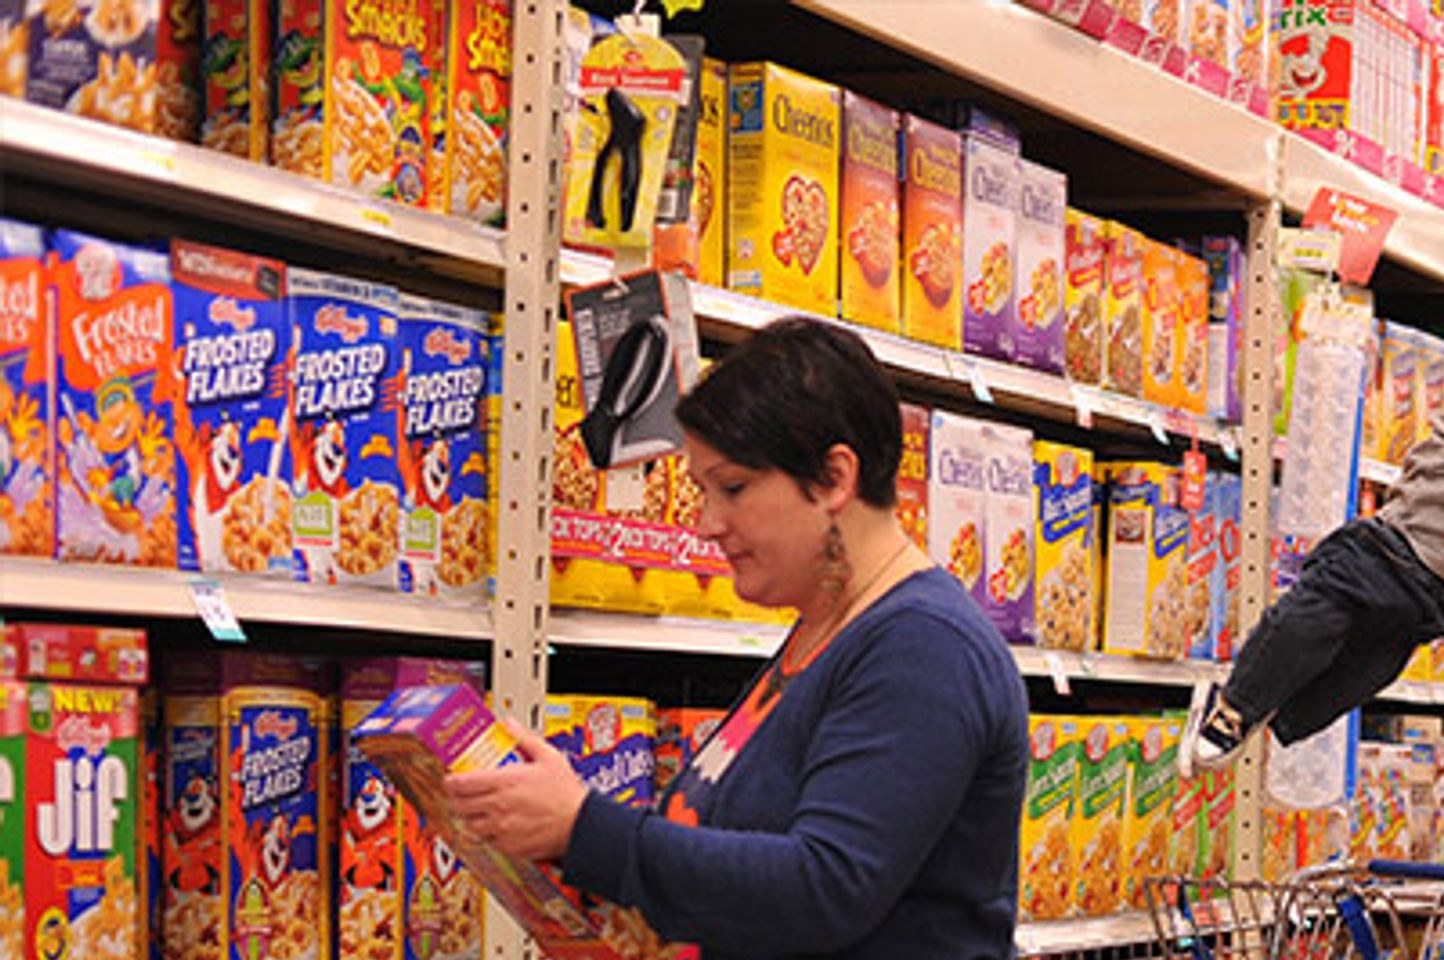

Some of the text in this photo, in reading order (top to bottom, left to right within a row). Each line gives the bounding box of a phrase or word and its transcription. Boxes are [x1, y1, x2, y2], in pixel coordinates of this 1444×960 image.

[1280, 0, 1327, 28] rix
[184, 329, 275, 372] FROSTED
[295, 344, 386, 385] FROSTED
[187, 363, 265, 403] FLAKES
[295, 376, 375, 417] FLAKES
[406, 366, 484, 406] FROSTED
[406, 395, 476, 436] FLAKES
[54, 687, 122, 713] NEW!
[243, 736, 311, 783] FROSTED
[37, 754, 127, 857] Jif
[242, 769, 301, 808] FLAKES
